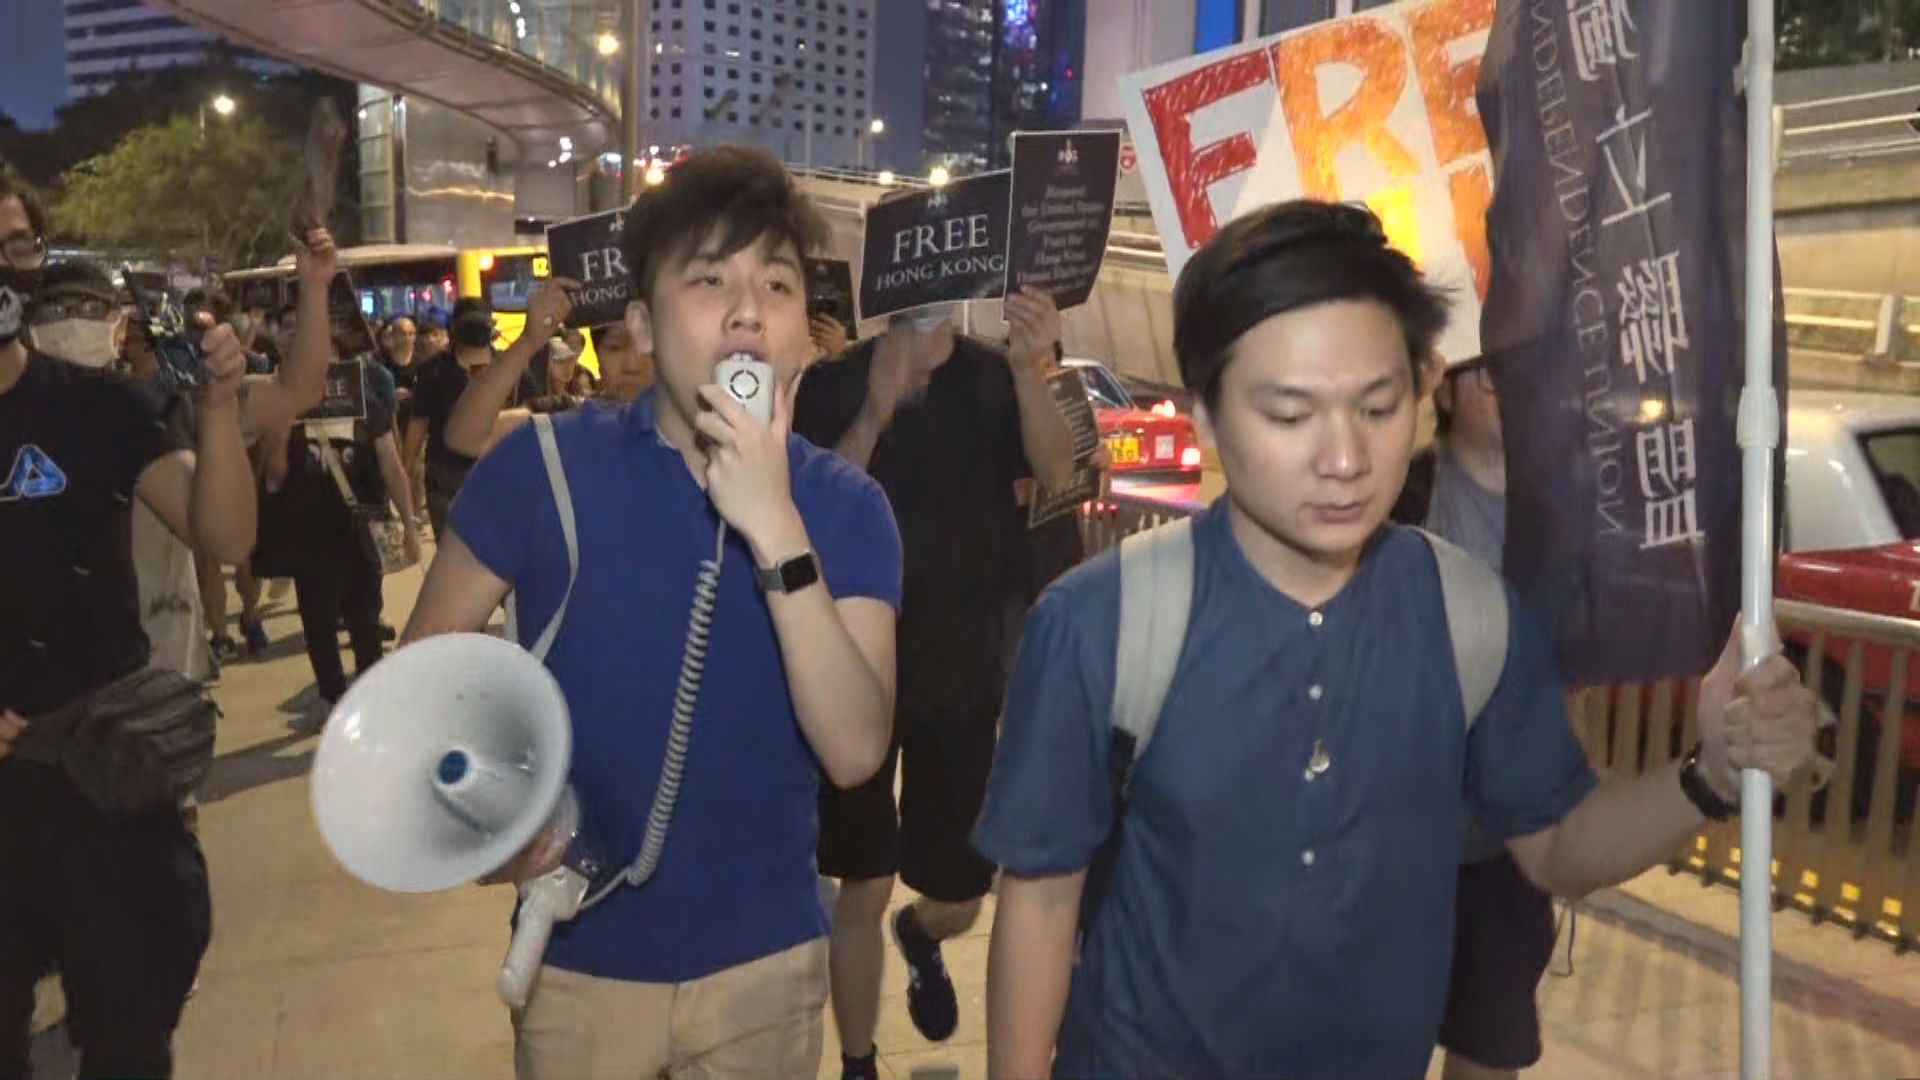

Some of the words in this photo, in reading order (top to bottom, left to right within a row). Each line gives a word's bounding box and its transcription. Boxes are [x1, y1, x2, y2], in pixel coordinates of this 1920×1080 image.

[1142, 0, 1495, 250] FRE
[892, 213, 989, 264] FREE
[579, 246, 630, 283] FR
[876, 263, 934, 292] HONG
[941, 253, 1004, 278] KONG
